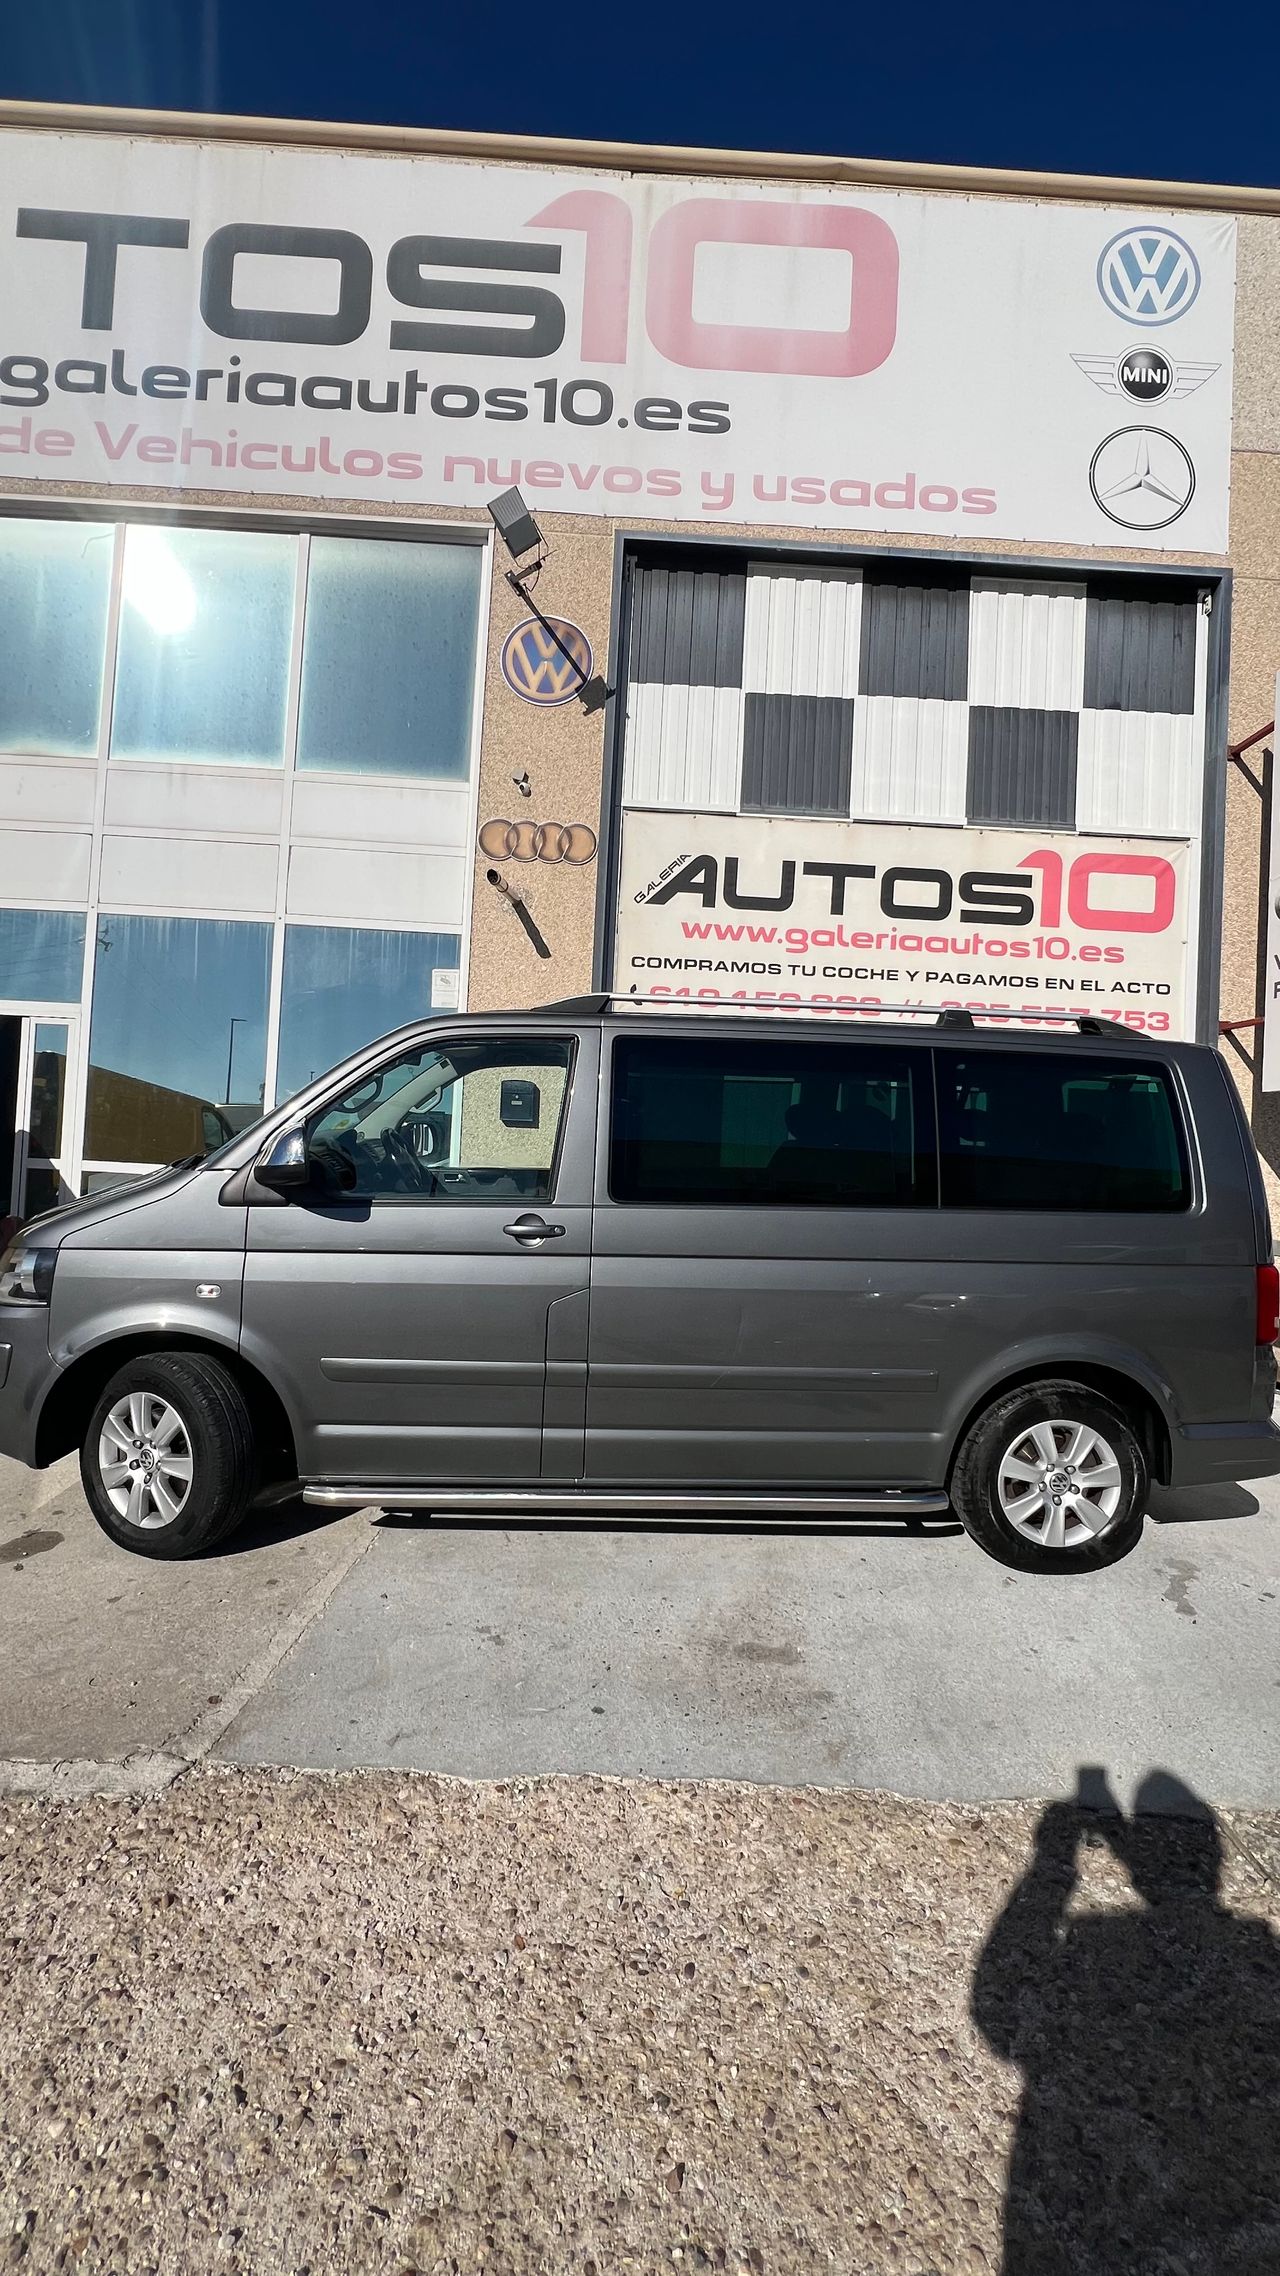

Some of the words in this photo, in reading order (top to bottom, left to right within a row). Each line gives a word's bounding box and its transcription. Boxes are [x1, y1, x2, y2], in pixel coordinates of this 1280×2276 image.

[16, 188, 900, 379] TOS10
[1123, 366, 1168, 385] MINI
[94, 421, 423, 481] Vehiculos
[443, 455, 682, 497] nuevos
[701, 471, 735, 511] y
[753, 473, 998, 515] usados
[633, 854, 692, 905] GALERIA
[644, 849, 1176, 934] AUTOS10
[681, 921, 1125, 964] www.galeriaautos10.es
[631, 956, 781, 976] COMPRAMOS
[788, 963, 816, 977] TU
[822, 966, 899, 982] COCHE
[905, 971, 920, 983] Y
[925, 971, 1039, 989] PAGAMOS
[1045, 978, 1074, 991] EN
[1080, 980, 1106, 993] EL
[1110, 982, 1171, 996] ACTO
